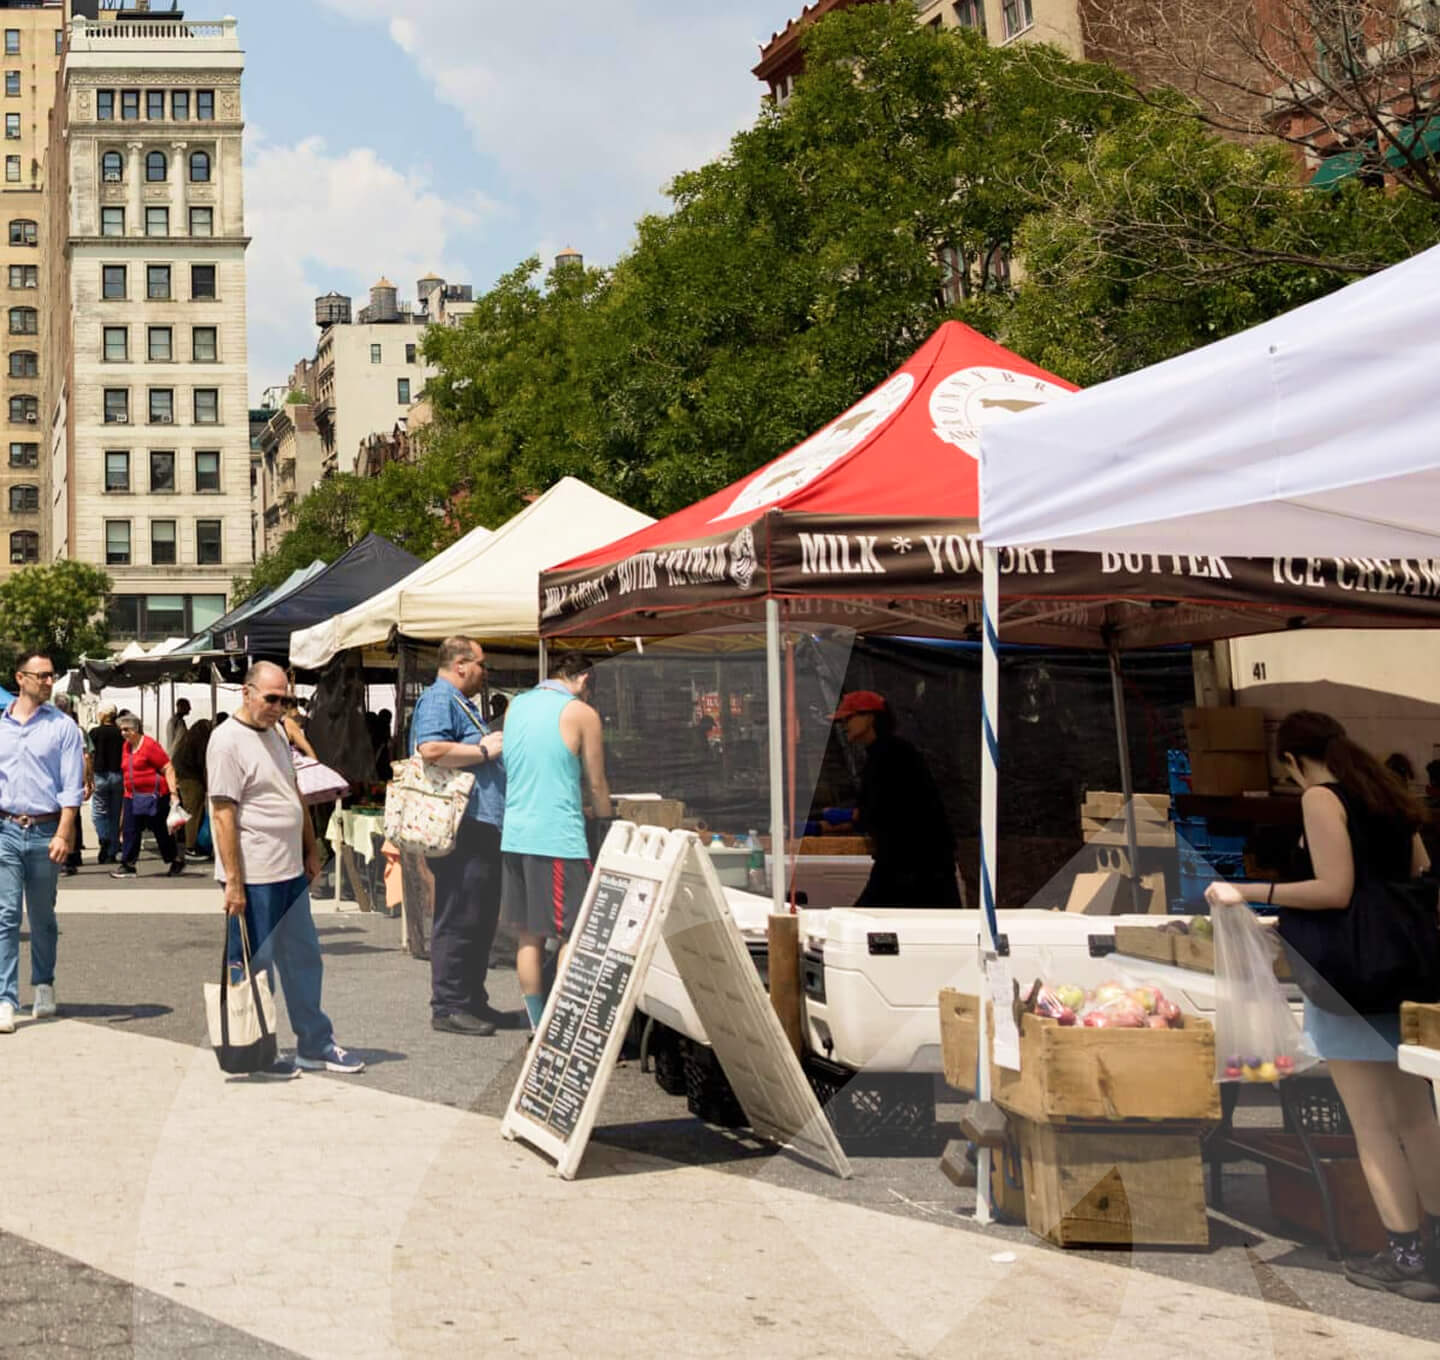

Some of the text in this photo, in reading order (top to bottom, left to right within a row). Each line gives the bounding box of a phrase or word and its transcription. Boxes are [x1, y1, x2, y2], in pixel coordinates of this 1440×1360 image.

[617, 552, 658, 595] BUTTER
[798, 532, 887, 574] MILK
[1252, 662, 1266, 681] 41
